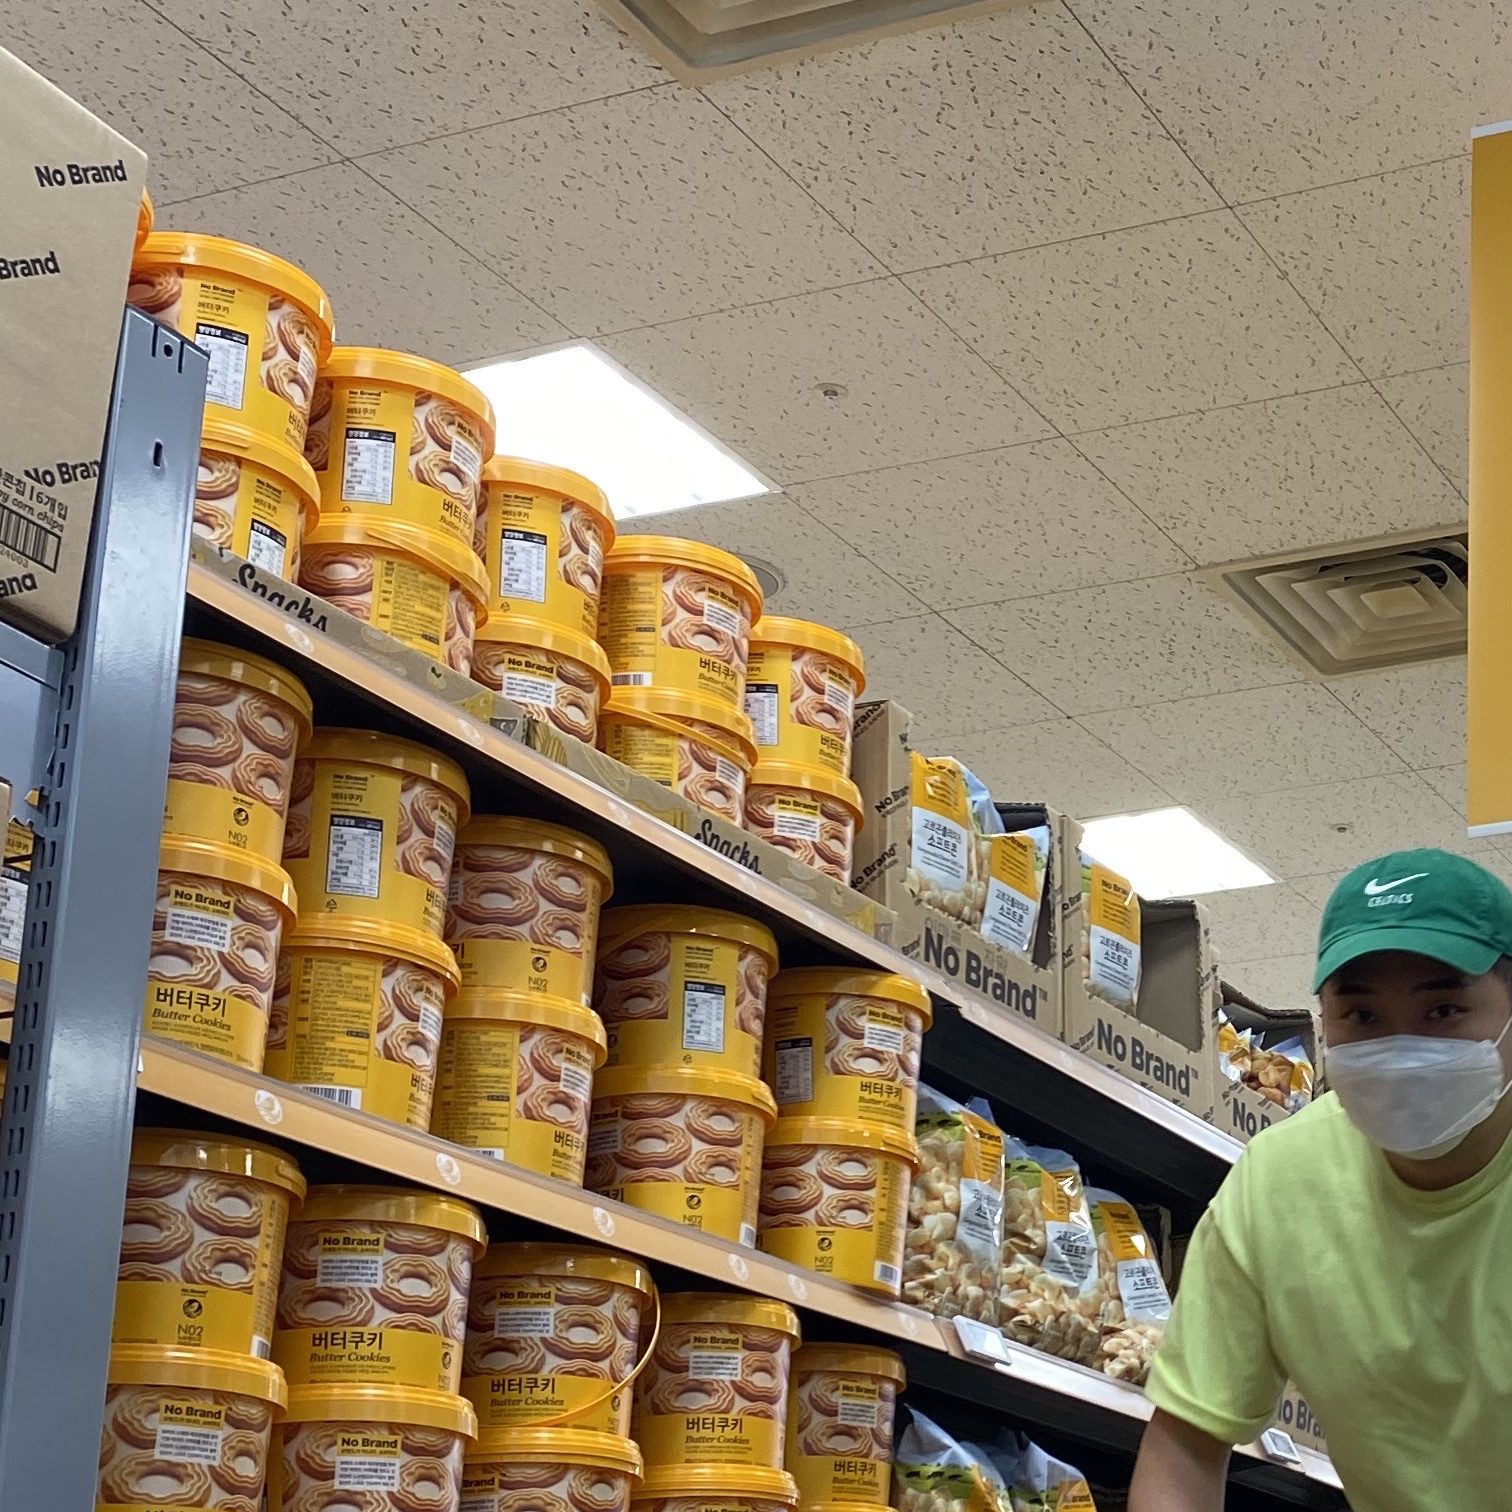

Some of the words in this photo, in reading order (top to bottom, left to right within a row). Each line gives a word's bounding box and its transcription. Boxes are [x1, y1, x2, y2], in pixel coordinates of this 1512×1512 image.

[35, 164, 67, 188] No
[70, 159, 128, 186] Brand
[56, 459, 101, 484] Bran
[0, 466, 27, 498] 콘칩
[0, 572, 38, 598] and
[230, 563, 328, 633] Snacks
[507, 657, 526, 669] No
[526, 659, 554, 675] Brand
[693, 818, 763, 876] Snacks
[862, 842, 898, 877] Brand
[174, 889, 193, 900] No
[194, 893, 231, 910] Brand
[923, 926, 960, 977] No
[155, 987, 227, 1018] 버터쿠키
[151, 1007, 191, 1022] Butter
[1097, 1017, 1127, 1062] No
[1232, 1097, 1258, 1138] No
[322, 1236, 340, 1247] No
[341, 1235, 381, 1248] Brand
[500, 1290, 516, 1301] No
[517, 1289, 552, 1301] Brand
[311, 1331, 383, 1351] 버터쿠키
[692, 1335, 705, 1345] No
[706, 1335, 739, 1347] Brand
[309, 1352, 345, 1363] Butter
[347, 1351, 391, 1364] Cookies
[490, 1377, 557, 1396] 버터쿠키
[853, 1385, 877, 1397] Brand
[489, 1396, 524, 1407] Butter
[525, 1396, 565, 1408] Cookies
[164, 1403, 183, 1416] No
[185, 1406, 222, 1421] Brand
[1296, 1399, 1323, 1437] Bra
[685, 1416, 744, 1435] 버터쿠키
[341, 1436, 360, 1447] No
[361, 1436, 398, 1449] Brand
[684, 1434, 716, 1445] Butter
[833, 1459, 877, 1478] 버터쿠키
